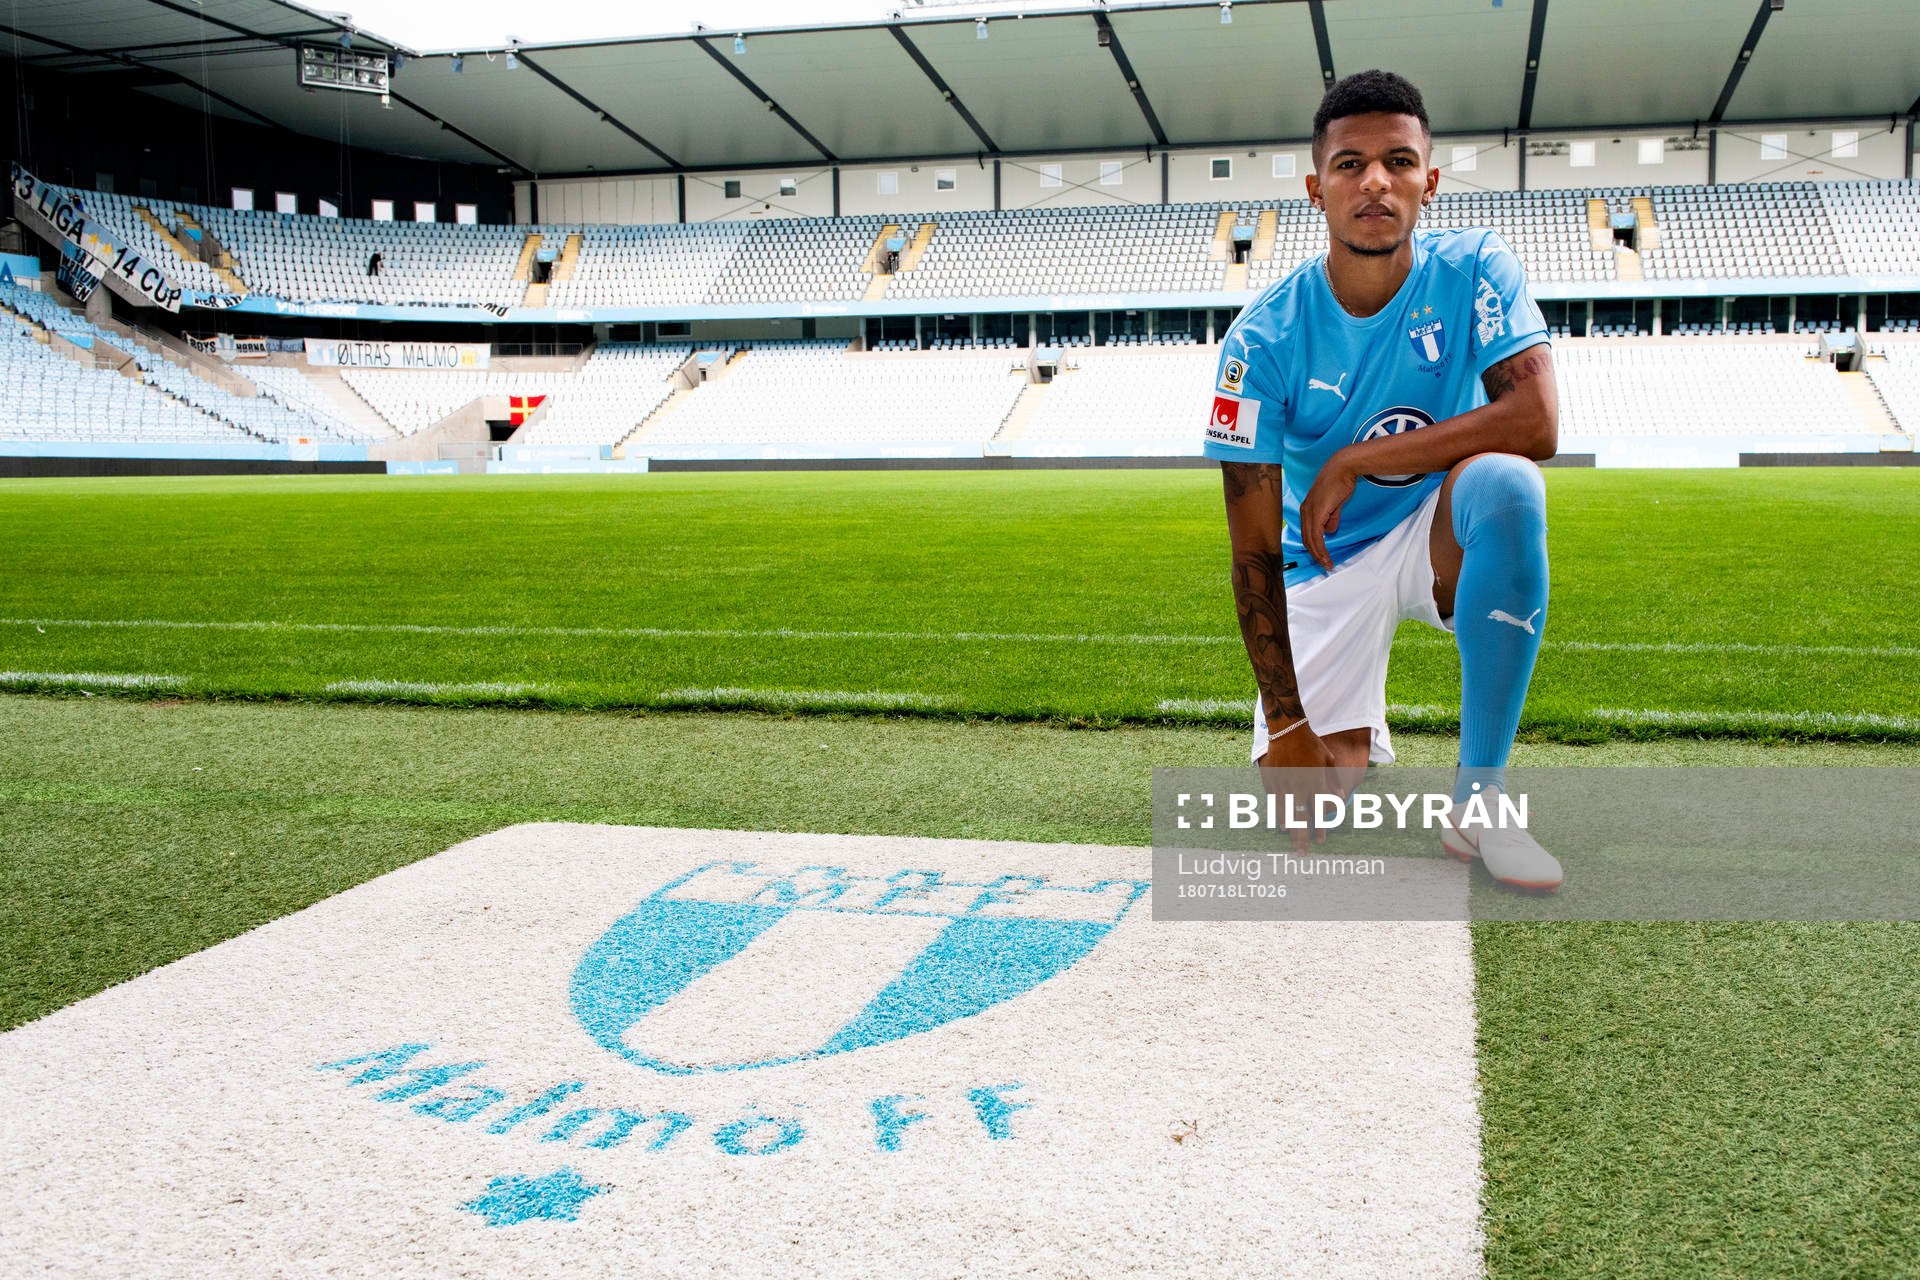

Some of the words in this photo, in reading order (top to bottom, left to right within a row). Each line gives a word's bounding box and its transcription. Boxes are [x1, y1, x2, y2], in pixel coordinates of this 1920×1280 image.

[38, 190, 86, 244] LIGA
[112, 248, 140, 279] 14
[140, 268, 182, 308] CUP
[337, 343, 391, 366] ØLTRAS
[1231, 434, 1250, 444] SPEL
